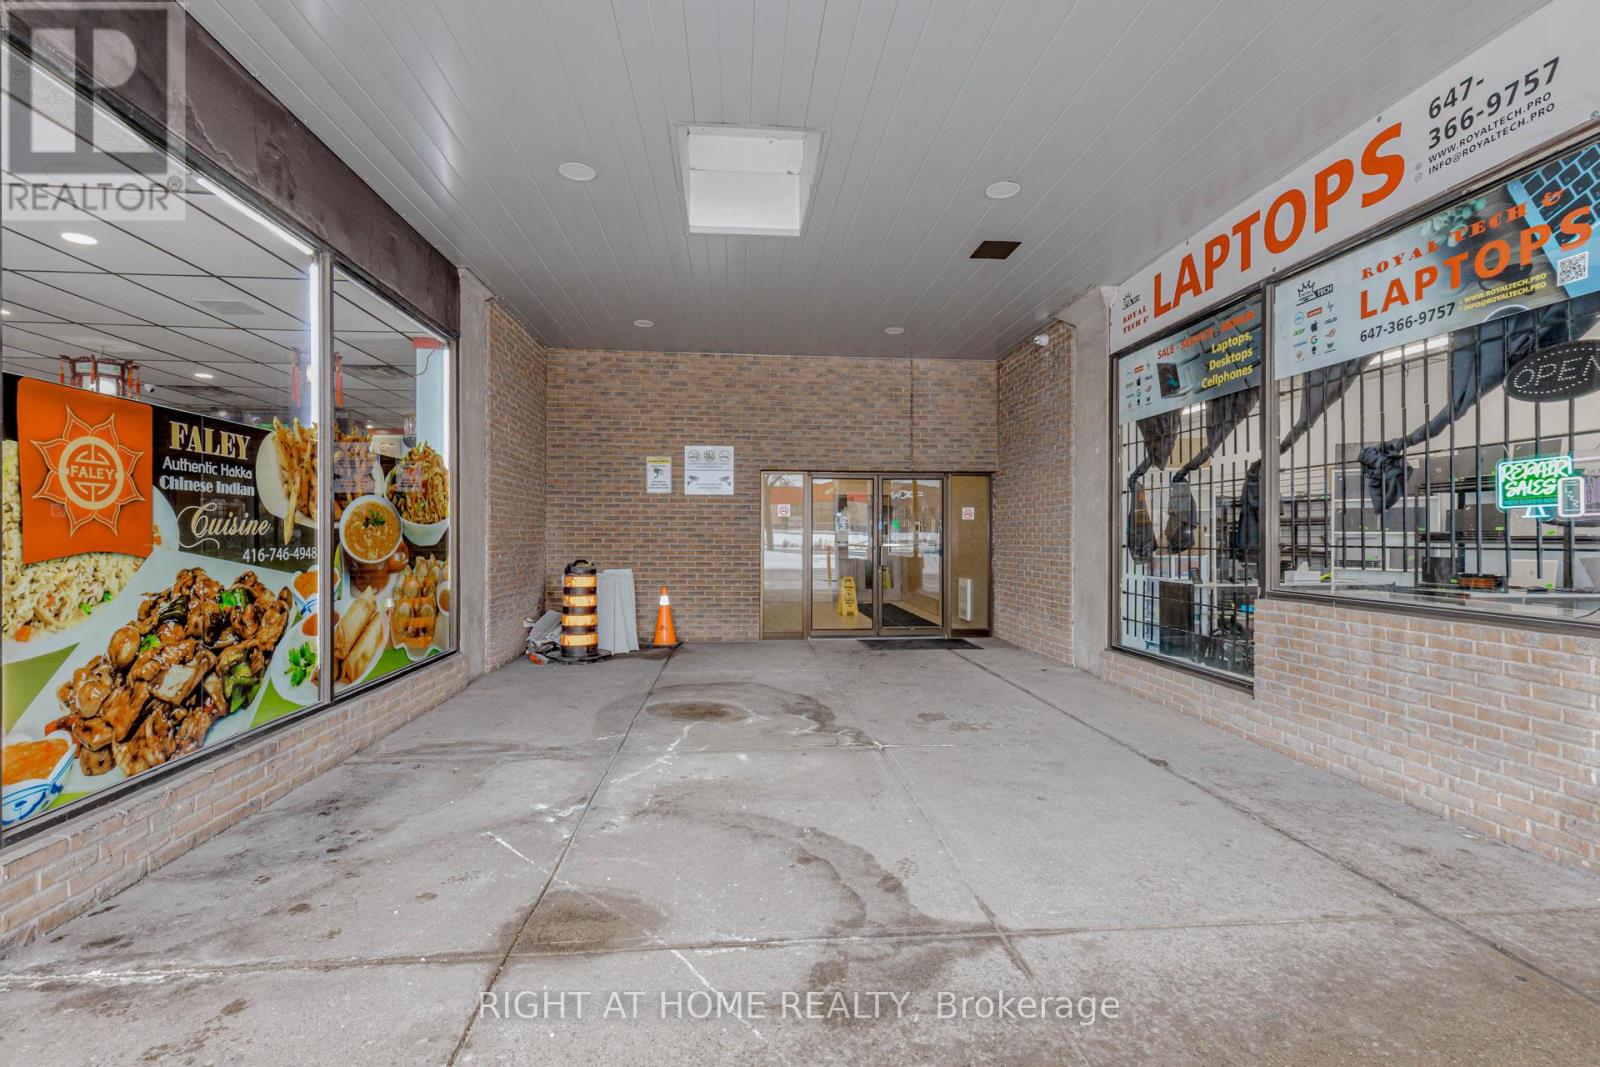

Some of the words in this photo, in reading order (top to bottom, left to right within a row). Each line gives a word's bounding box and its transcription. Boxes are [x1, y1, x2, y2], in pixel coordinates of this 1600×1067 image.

[1428, 76, 1485, 119] 647-
[1428, 56, 1560, 150] 366-9757
[1428, 92, 1552, 163] WWW.ROYALTECH.PRO
[1428, 103, 1556, 175] INFO@ROYALTECH.PRO
[1153, 122, 1405, 319] LAPTOPS
[1361, 239, 1442, 281] ROYAL
[1450, 202, 1528, 244] TECH
[1360, 205, 1593, 320] LAPTOPS
[1359, 302, 1456, 343] 647-366-9757
[1157, 344, 1176, 359] SALE
[1208, 347, 1254, 371] Desktops
[1211, 332, 1253, 354] Laptops,
[1201, 364, 1254, 389] Cellphones
[169, 421, 251, 461] FALEY
[70, 464, 114, 480] FALEY
[162, 456, 218, 475] Authentic
[220, 463, 253, 479] Hakka
[1501, 460, 1568, 481] REPAIR
[159, 475, 214, 493] Chinese
[216, 481, 255, 497] Indian
[1505, 478, 1557, 497] SALES
[180, 502, 271, 543] Cuisine
[242, 547, 318, 563] 416-746-4948
